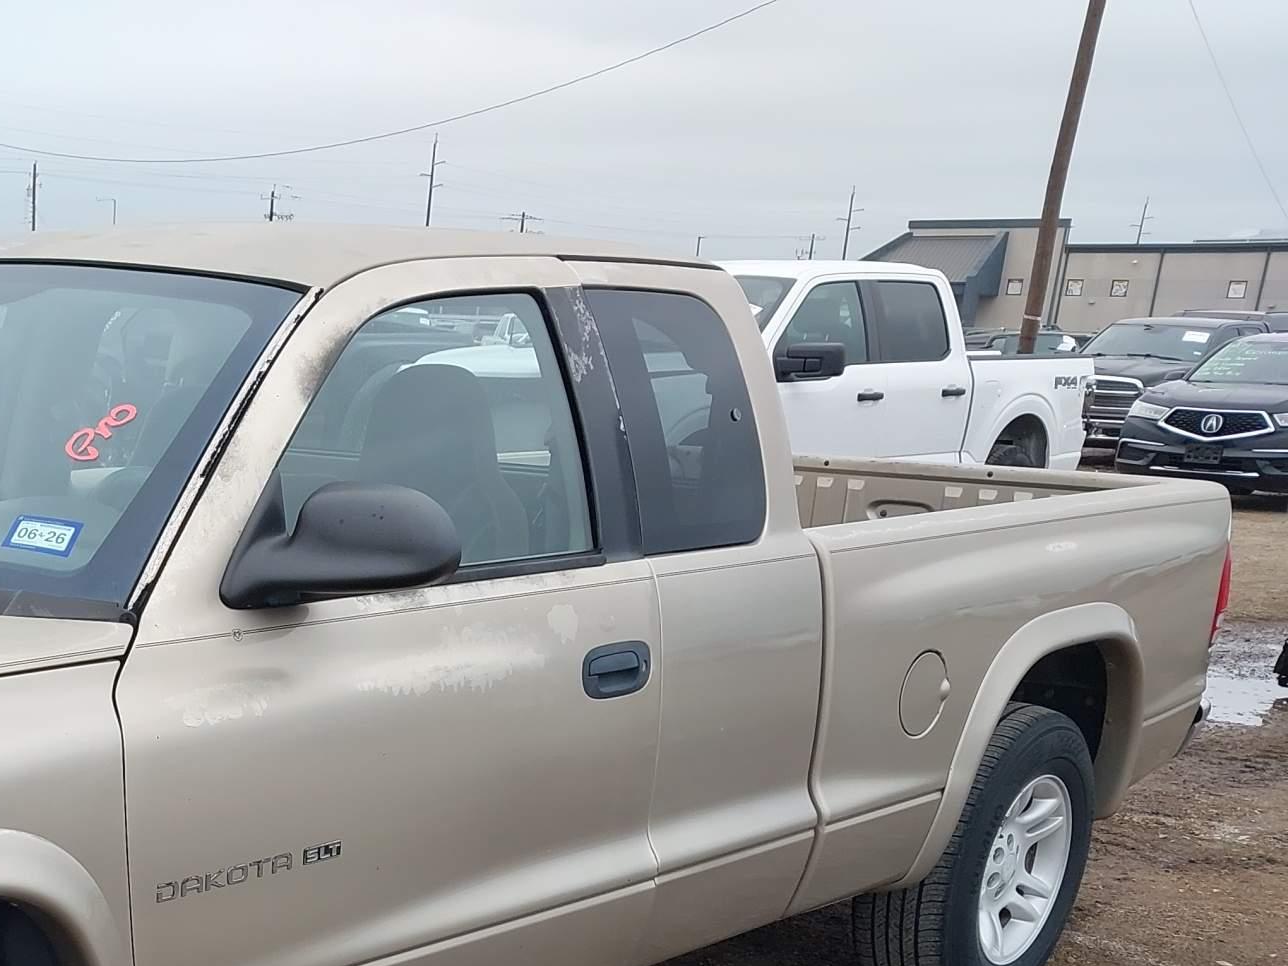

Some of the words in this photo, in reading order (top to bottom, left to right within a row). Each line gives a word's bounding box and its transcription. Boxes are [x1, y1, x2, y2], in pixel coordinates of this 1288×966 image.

[1054, 376, 1078, 389] FX4
[18, 528, 39, 540] 06
[44, 532, 67, 544] 26
[156, 852, 293, 904] DAKOTA
[304, 841, 341, 865] SLT
